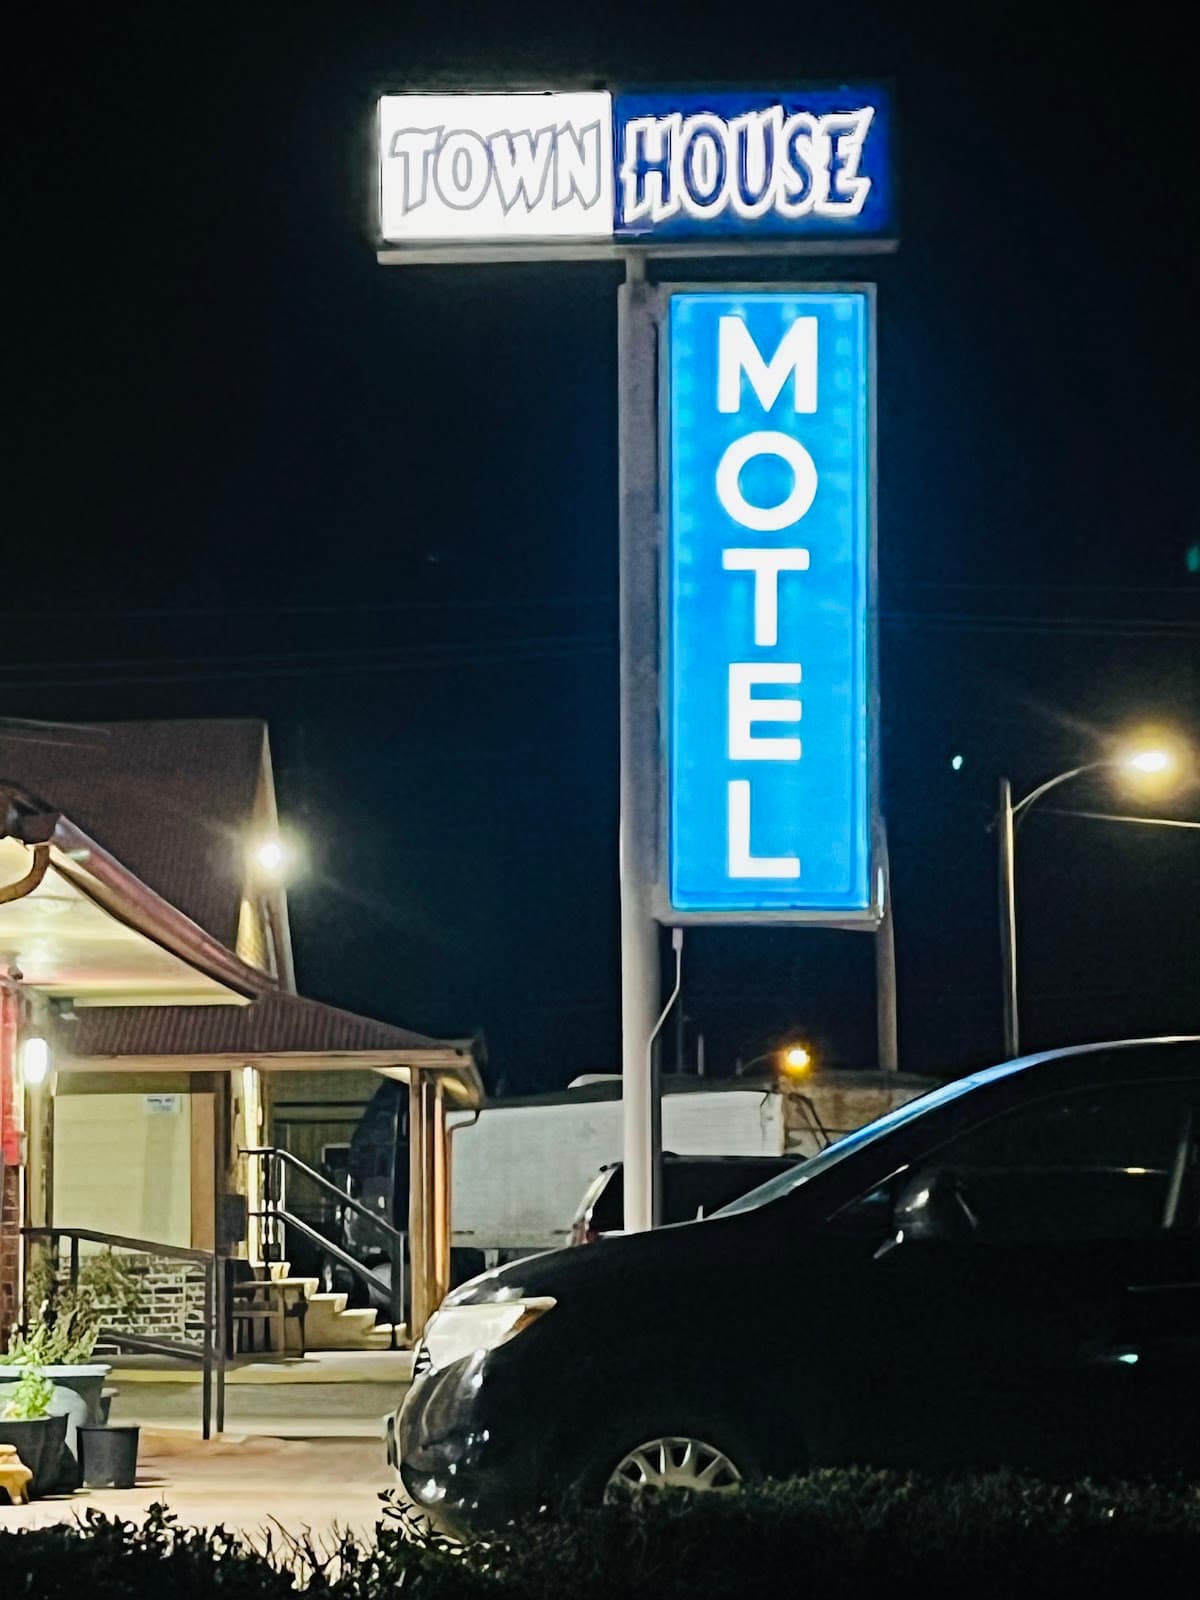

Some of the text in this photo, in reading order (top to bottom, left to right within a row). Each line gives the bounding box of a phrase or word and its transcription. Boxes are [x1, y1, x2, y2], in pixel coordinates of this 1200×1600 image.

[389, 105, 875, 221] TOWN HOUSE
[715, 316, 818, 879] MOTEL
